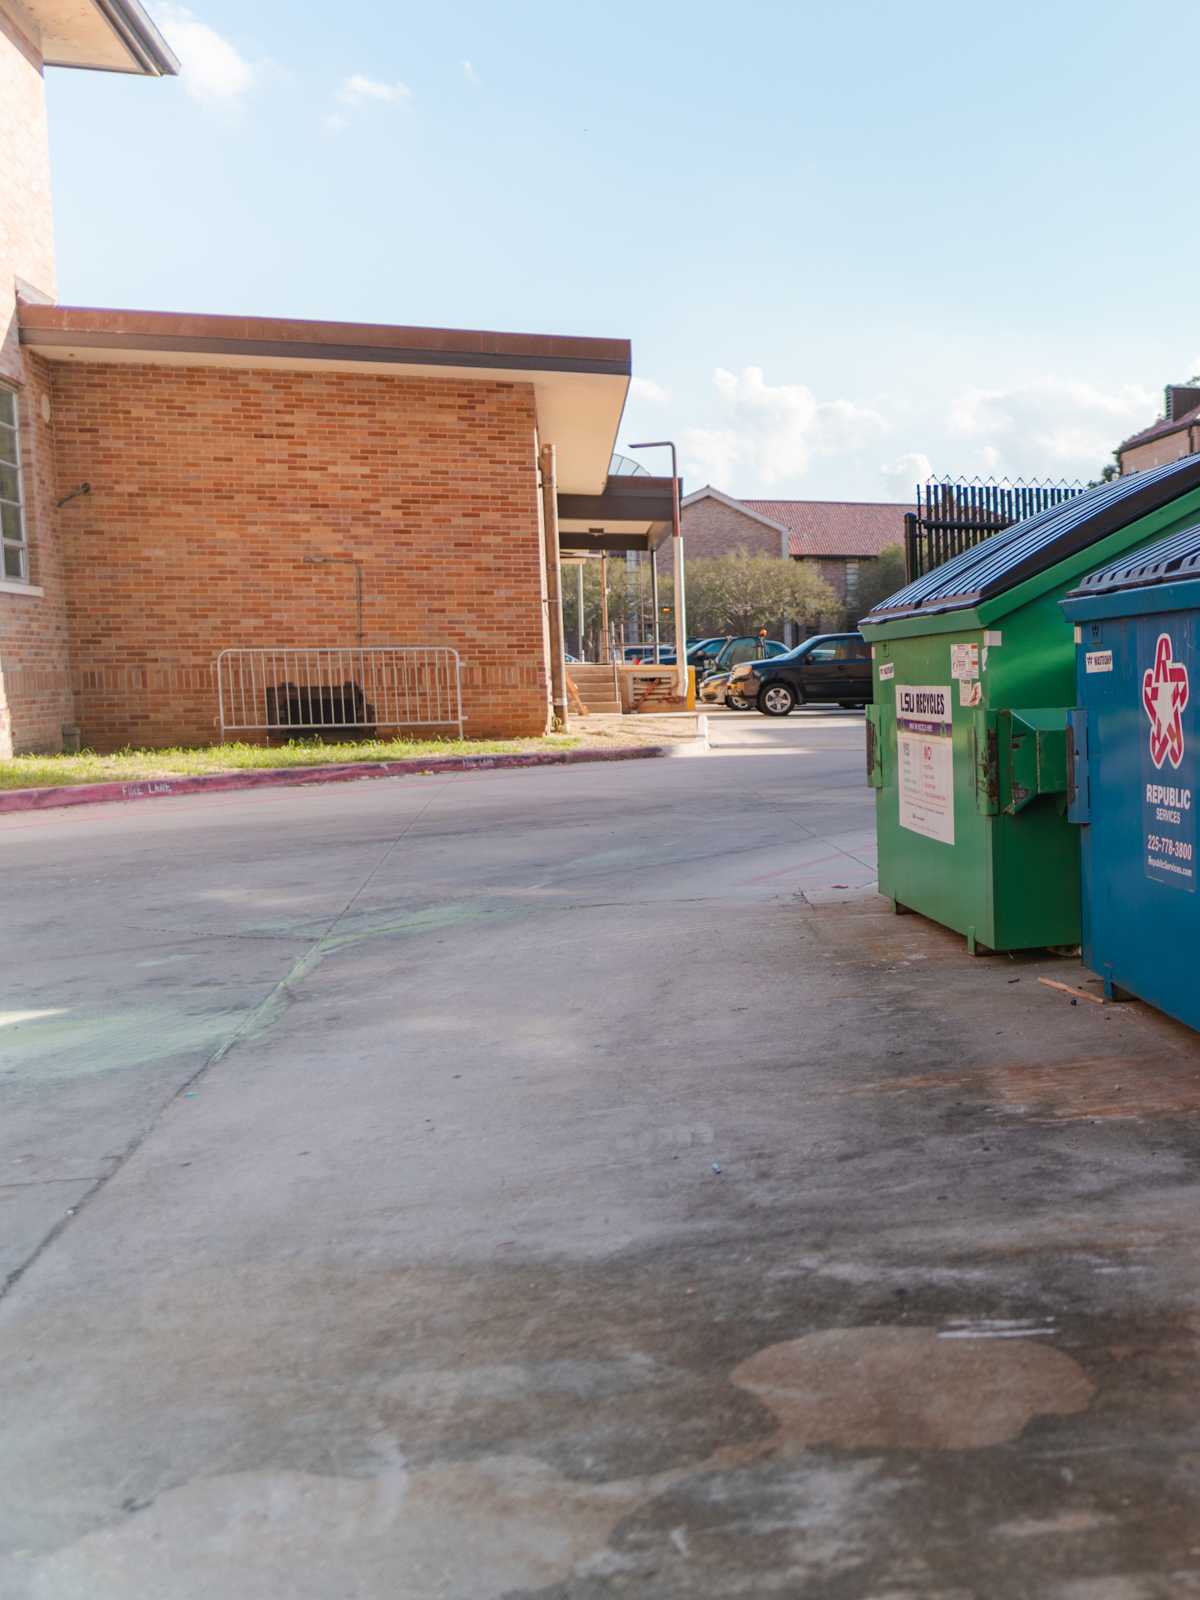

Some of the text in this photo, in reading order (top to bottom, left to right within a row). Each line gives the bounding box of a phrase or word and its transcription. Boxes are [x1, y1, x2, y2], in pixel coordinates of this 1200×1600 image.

[900, 692, 945, 715] LSU RECYCLES
[1146, 784, 1191, 810] REPUBLIC
[1156, 807, 1181, 824] SERVICES
[1147, 834, 1192, 861] 225-778-3800
